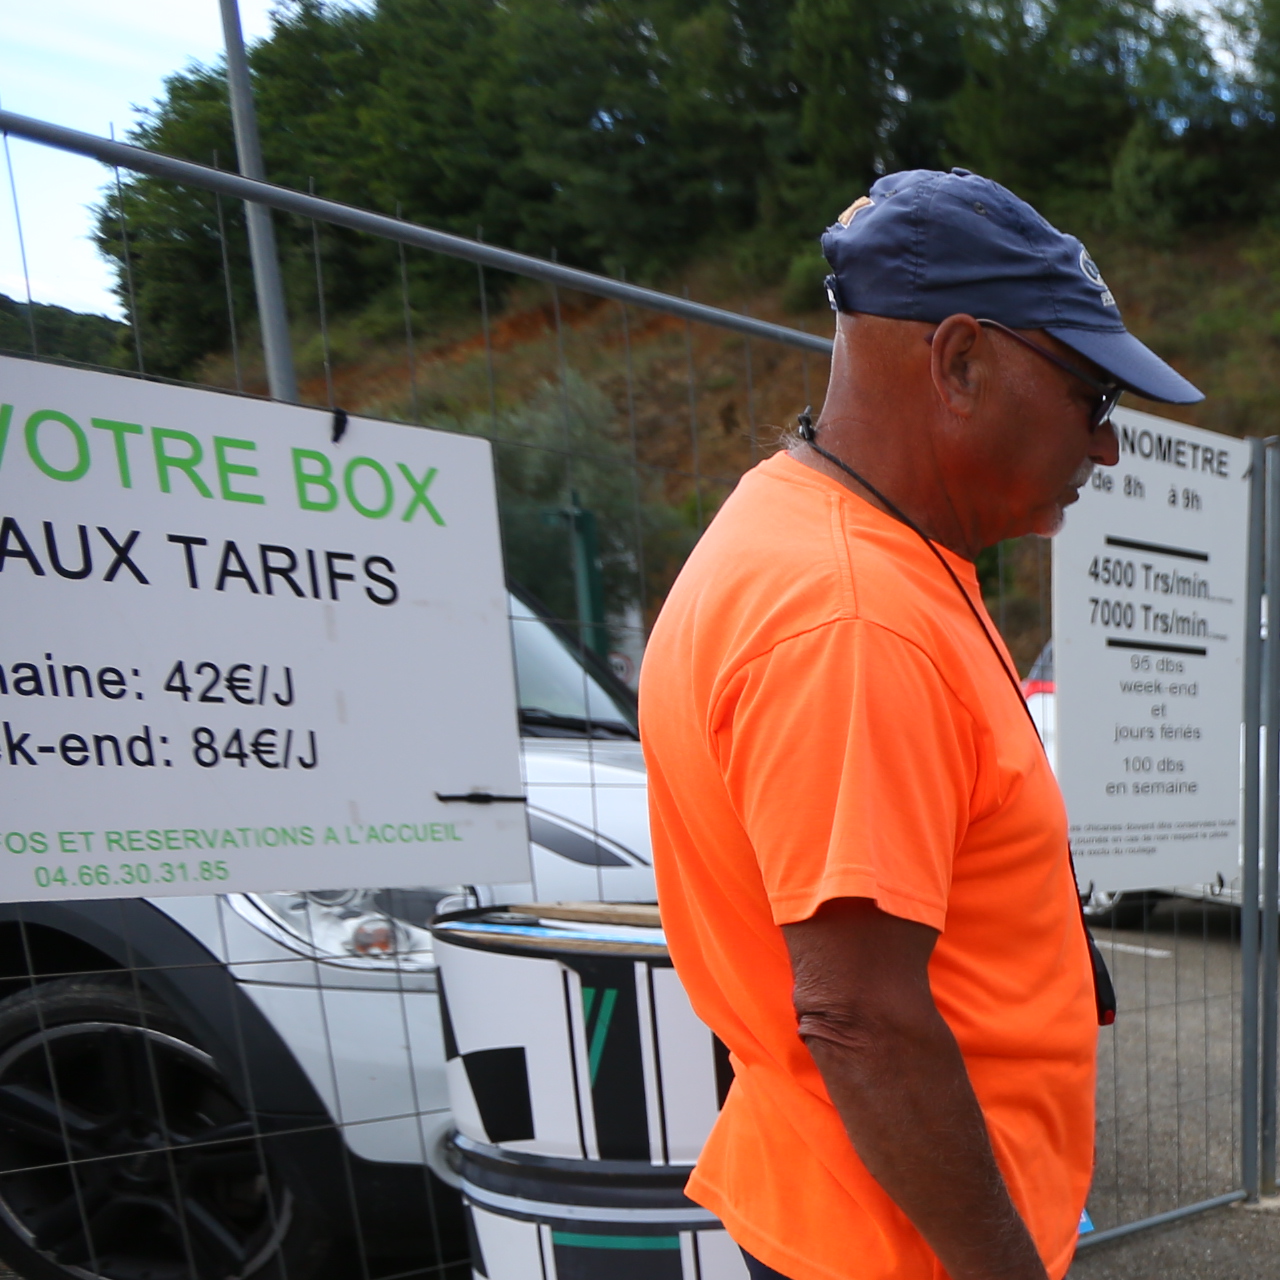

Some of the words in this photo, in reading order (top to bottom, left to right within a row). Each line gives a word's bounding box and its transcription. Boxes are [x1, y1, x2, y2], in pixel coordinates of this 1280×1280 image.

[0, 404, 266, 505] OTRE
[291, 446, 447, 527] BOX
[1120, 425, 1229, 478] NOMETRE
[1092, 471, 1114, 493] de
[1123, 474, 1145, 499] 8h
[1182, 487, 1202, 510] 9h
[167, 533, 399, 607] TARIFS
[1087, 556, 1135, 588] 4500
[1088, 598, 1135, 630] 7000
[0, 653, 144, 701] aine:
[164, 660, 296, 707] 42€/J
[1155, 656, 1185, 674] dbs
[1150, 703, 1167, 717] et
[0, 721, 172, 768] k-end:
[191, 726, 319, 771] 84€/J
[1113, 724, 1155, 743] jours
[1160, 724, 1201, 740] fériés
[1122, 756, 1152, 773] 100
[1156, 757, 1185, 773] dbs
[1105, 782, 1126, 796] en
[1131, 780, 1199, 795] semaine
[0, 831, 49, 855] OS
[58, 830, 96, 854] ET
[106, 825, 316, 853] RESERVATIONS
[323, 825, 341, 845] A
[346, 821, 464, 845] L'ACCUEIL
[34, 860, 230, 888] 04.66.30.31.85
